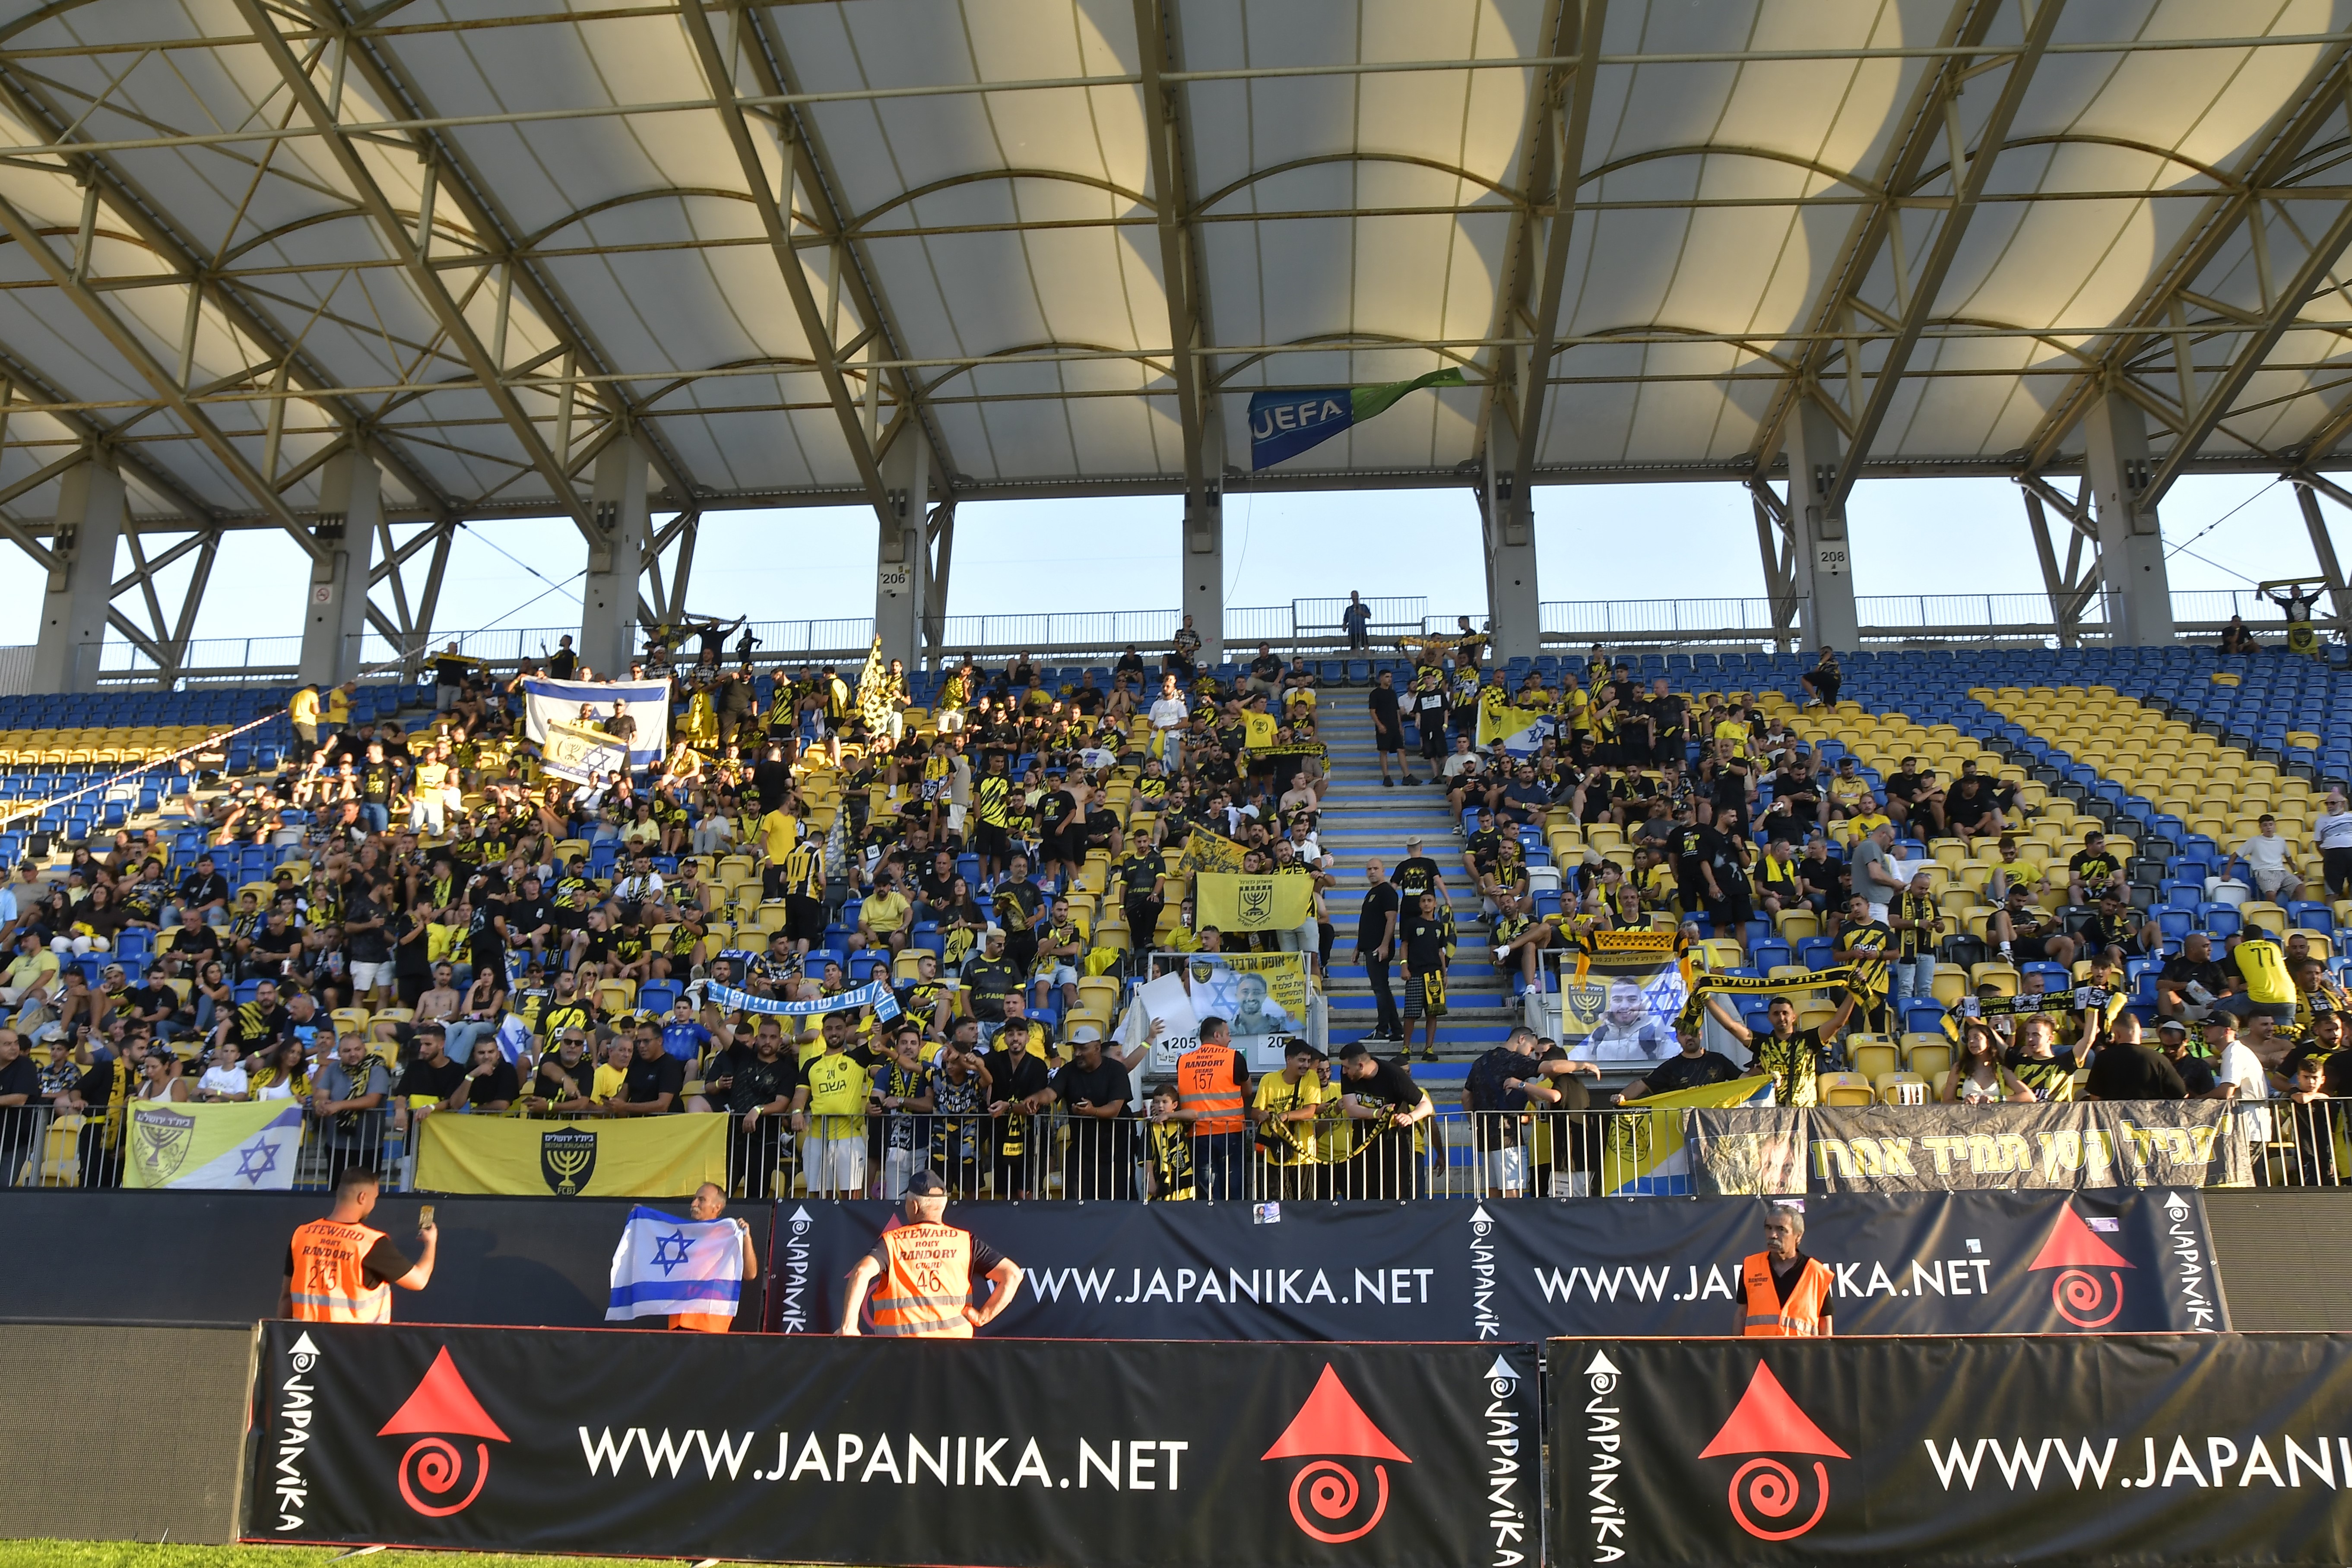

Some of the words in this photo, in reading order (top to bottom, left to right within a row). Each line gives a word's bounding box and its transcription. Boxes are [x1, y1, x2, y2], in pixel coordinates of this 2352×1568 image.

[1821, 551, 1845, 562] 208
[883, 573, 905, 584] 206
[1230, 957, 1257, 971] ארביב
[1262, 955, 1284, 970] אופק
[2250, 947, 2275, 967] 77
[1709, 976, 1775, 987] ירושלים
[1780, 972, 1827, 985] בית"ר
[844, 989, 866, 1005] עם
[1171, 1037, 1196, 1049] 205
[1268, 1036, 1285, 1048] 20
[1185, 1060, 1224, 1069] RANDORY
[819, 1080, 846, 1093] גשם
[1193, 1073, 1213, 1090] 157
[1810, 1135, 1916, 1179] אמרו
[1922, 1133, 2034, 1175] תמיד
[2036, 1128, 2117, 1182] קטן
[305, 1225, 365, 1242] STEWARD
[894, 1228, 957, 1239] STEWARD
[303, 1246, 353, 1261] RANDORY
[898, 1249, 957, 1261] RANDORY
[308, 1266, 337, 1290] 215
[917, 1270, 941, 1292] 46
[1534, 1260, 1991, 1303] WWW.JAKA.NET
[578, 1425, 1188, 1491] WWW.JAPANIKA.NET
